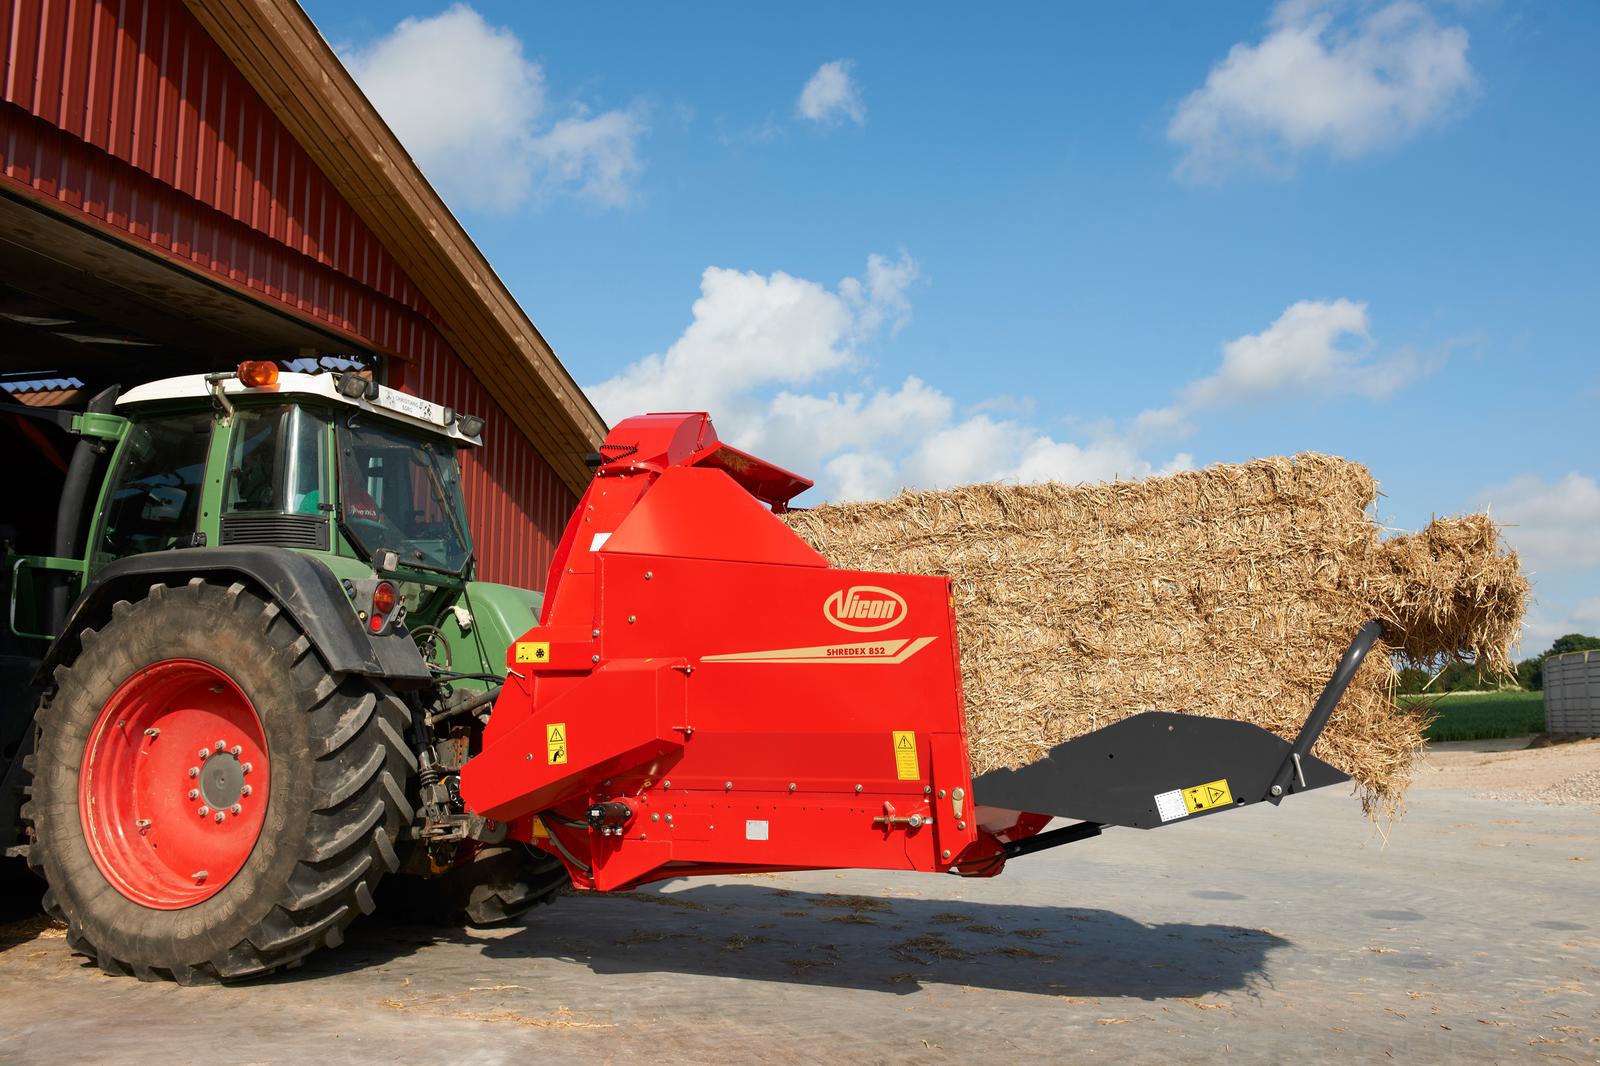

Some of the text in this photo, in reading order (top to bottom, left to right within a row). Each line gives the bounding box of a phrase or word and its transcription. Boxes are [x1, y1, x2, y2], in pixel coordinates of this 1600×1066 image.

[836, 589, 897, 619] Vicon
[826, 646, 886, 656] SHREDEX 852
